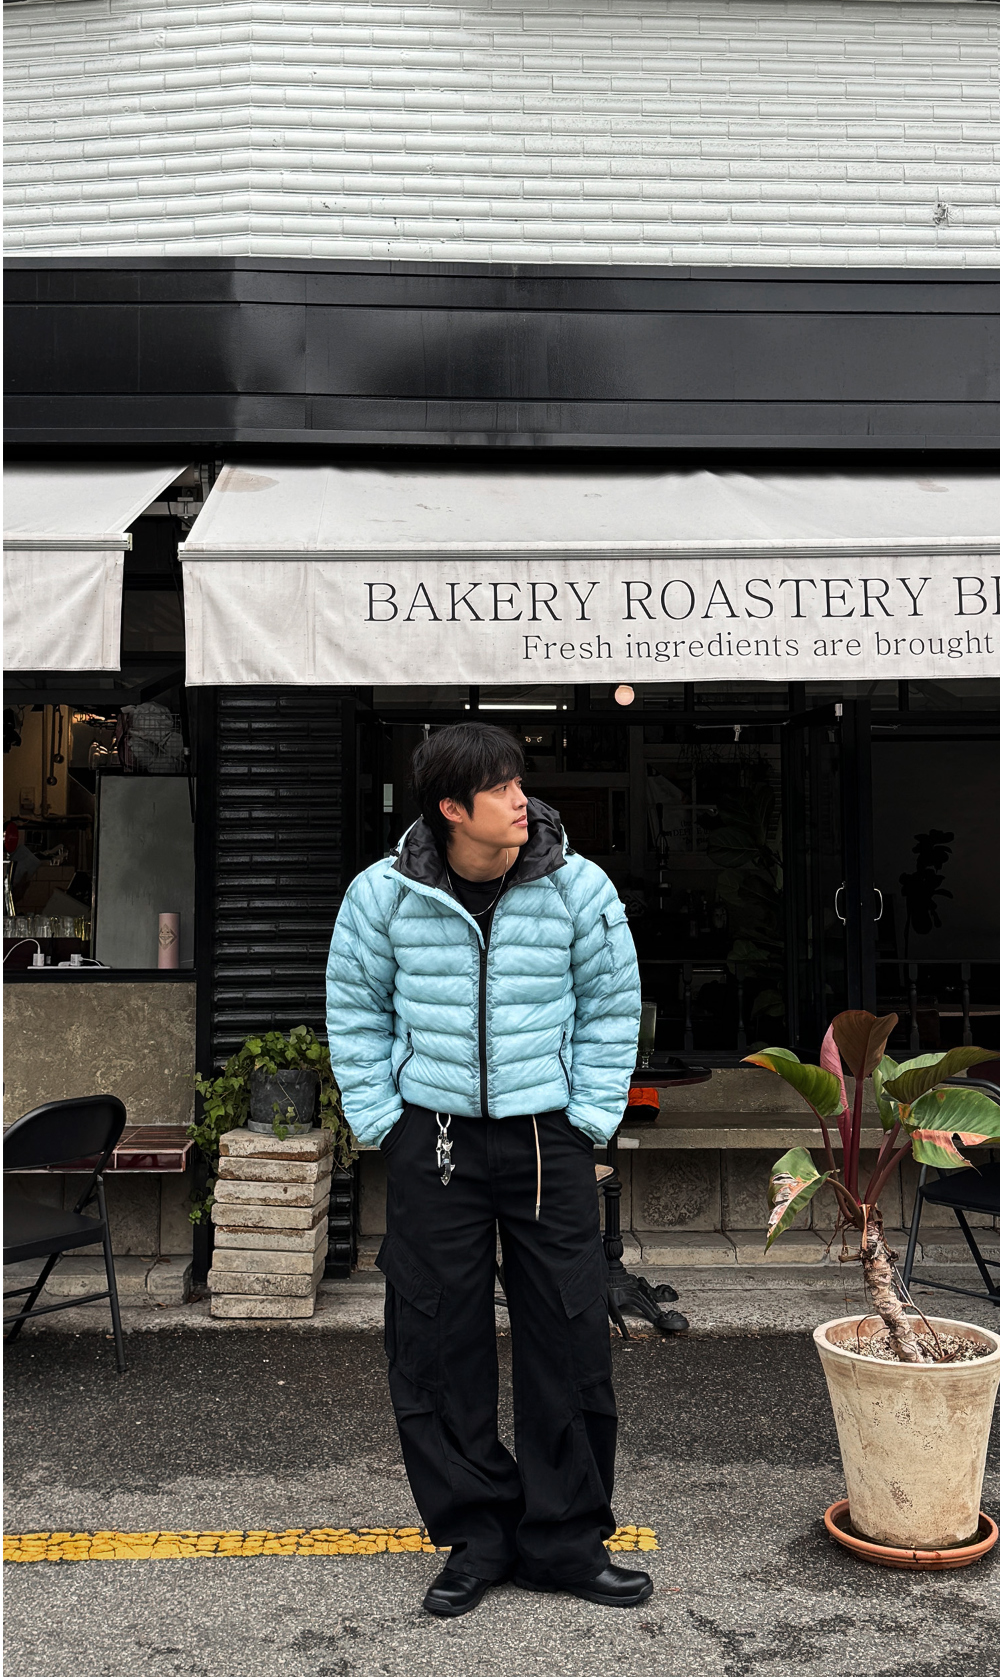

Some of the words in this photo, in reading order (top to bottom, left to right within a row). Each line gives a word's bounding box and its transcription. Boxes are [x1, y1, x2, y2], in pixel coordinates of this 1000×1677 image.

[363, 581, 601, 622] BAKERY
[621, 577, 932, 620] ROASTERY
[953, 575, 1000, 616] B
[522, 634, 613, 660] Fresh
[626, 632, 799, 662] ingredients
[813, 638, 861, 657] are
[875, 629, 995, 659] brought
